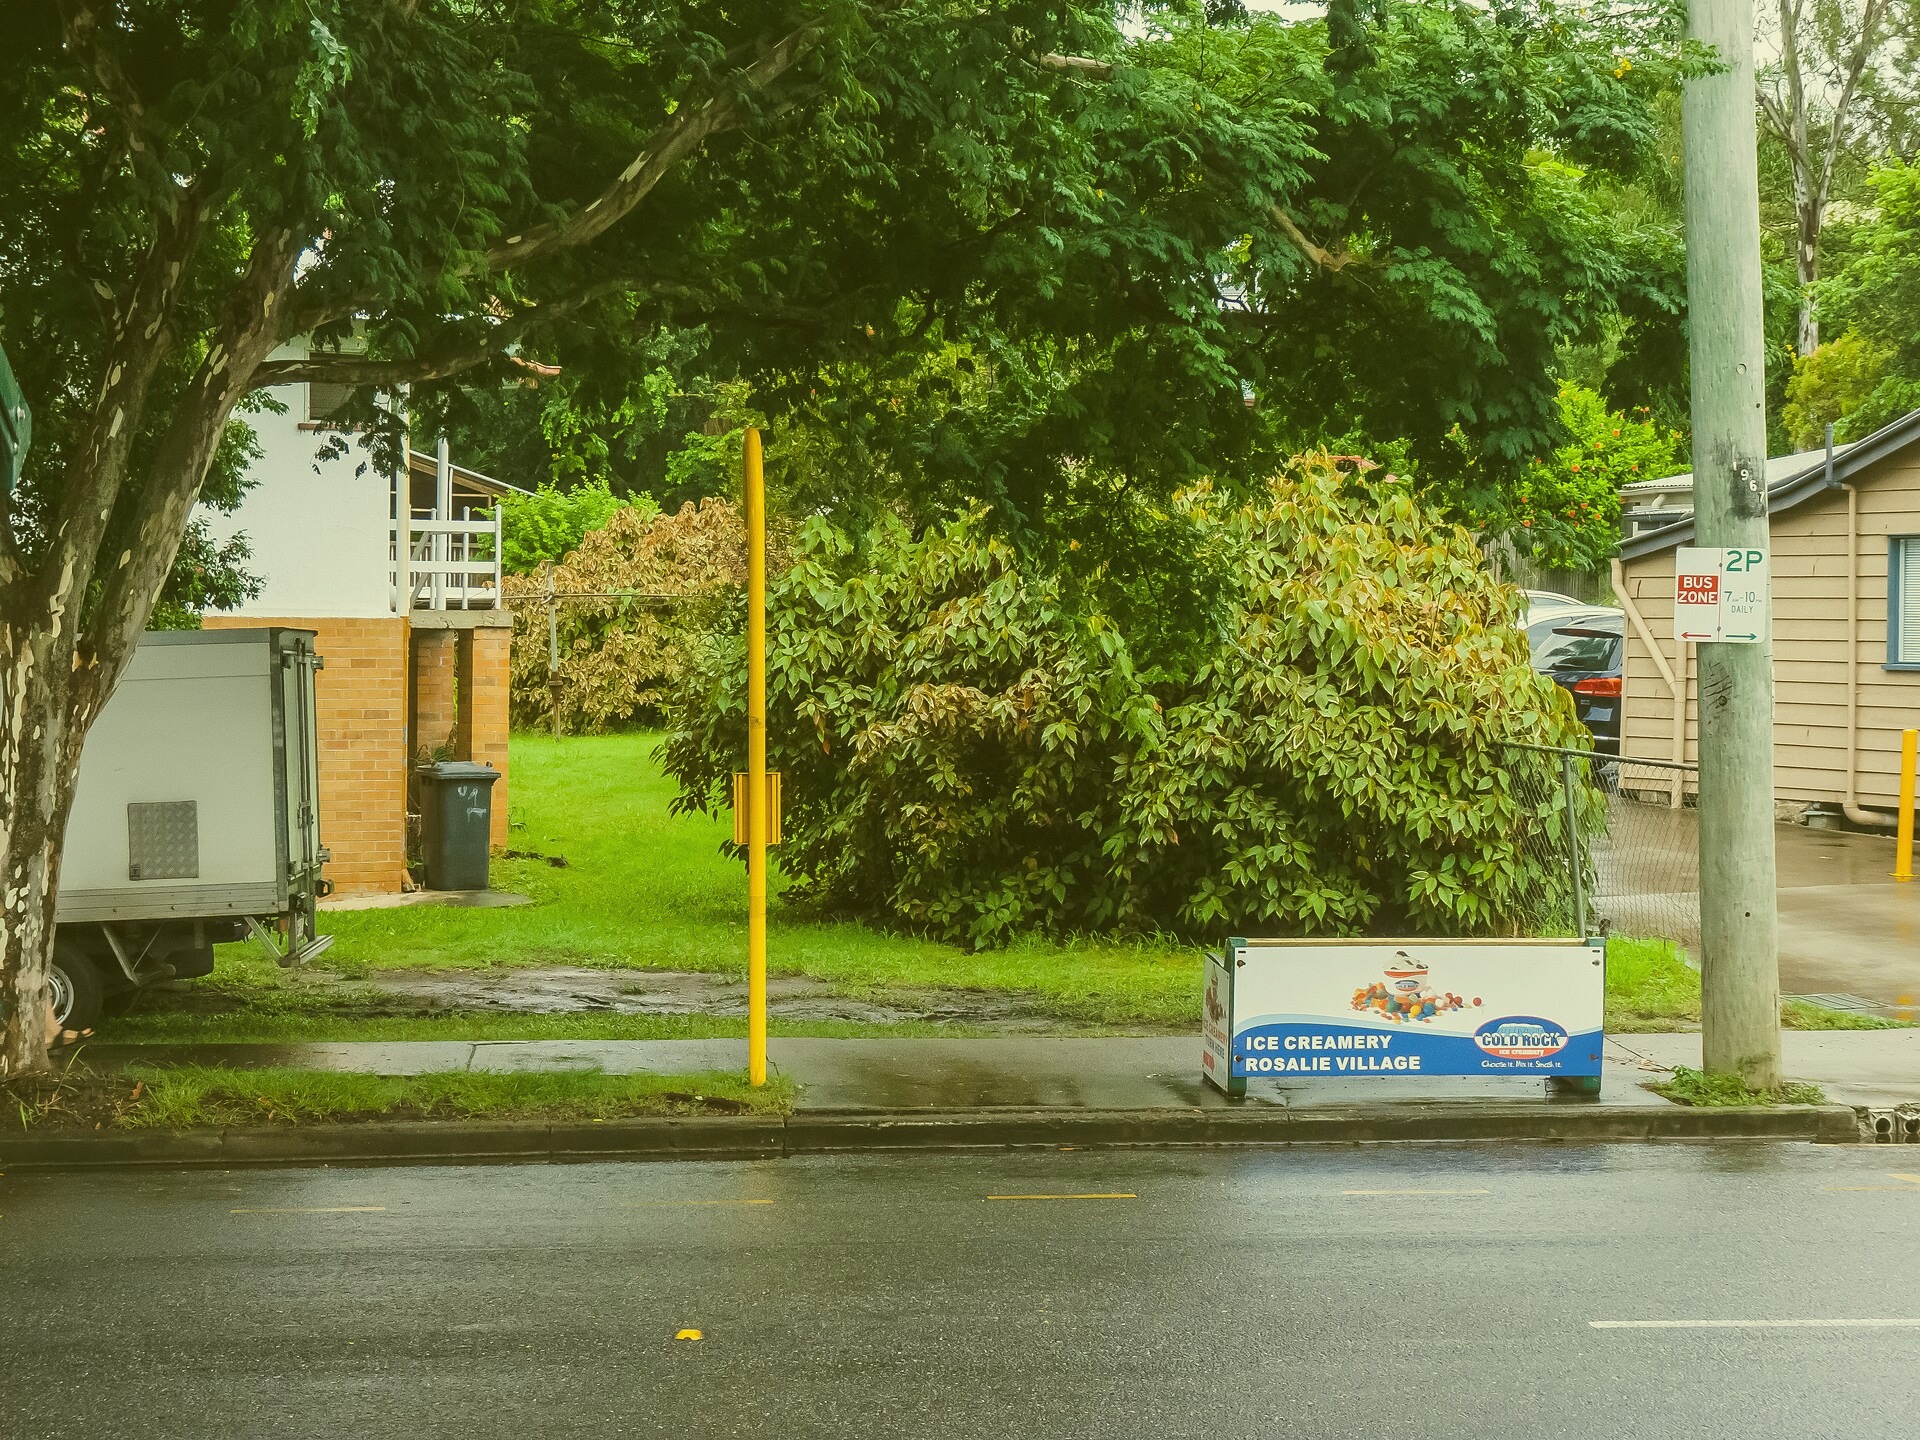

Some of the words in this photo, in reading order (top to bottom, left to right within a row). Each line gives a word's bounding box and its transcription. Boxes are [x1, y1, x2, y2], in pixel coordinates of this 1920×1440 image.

[1725, 550, 1763, 572] 2P
[1683, 576, 1713, 588] BUS
[1678, 591, 1717, 603] ZONE
[1731, 604, 1753, 613] DAILY
[1246, 1036, 1279, 1051] ICE
[1284, 1035, 1392, 1050] CREAMERY
[1522, 1032, 1560, 1047] ROCK
[1245, 1057, 1331, 1072] ROSALIE
[1336, 1056, 1421, 1071] VILLAGE
